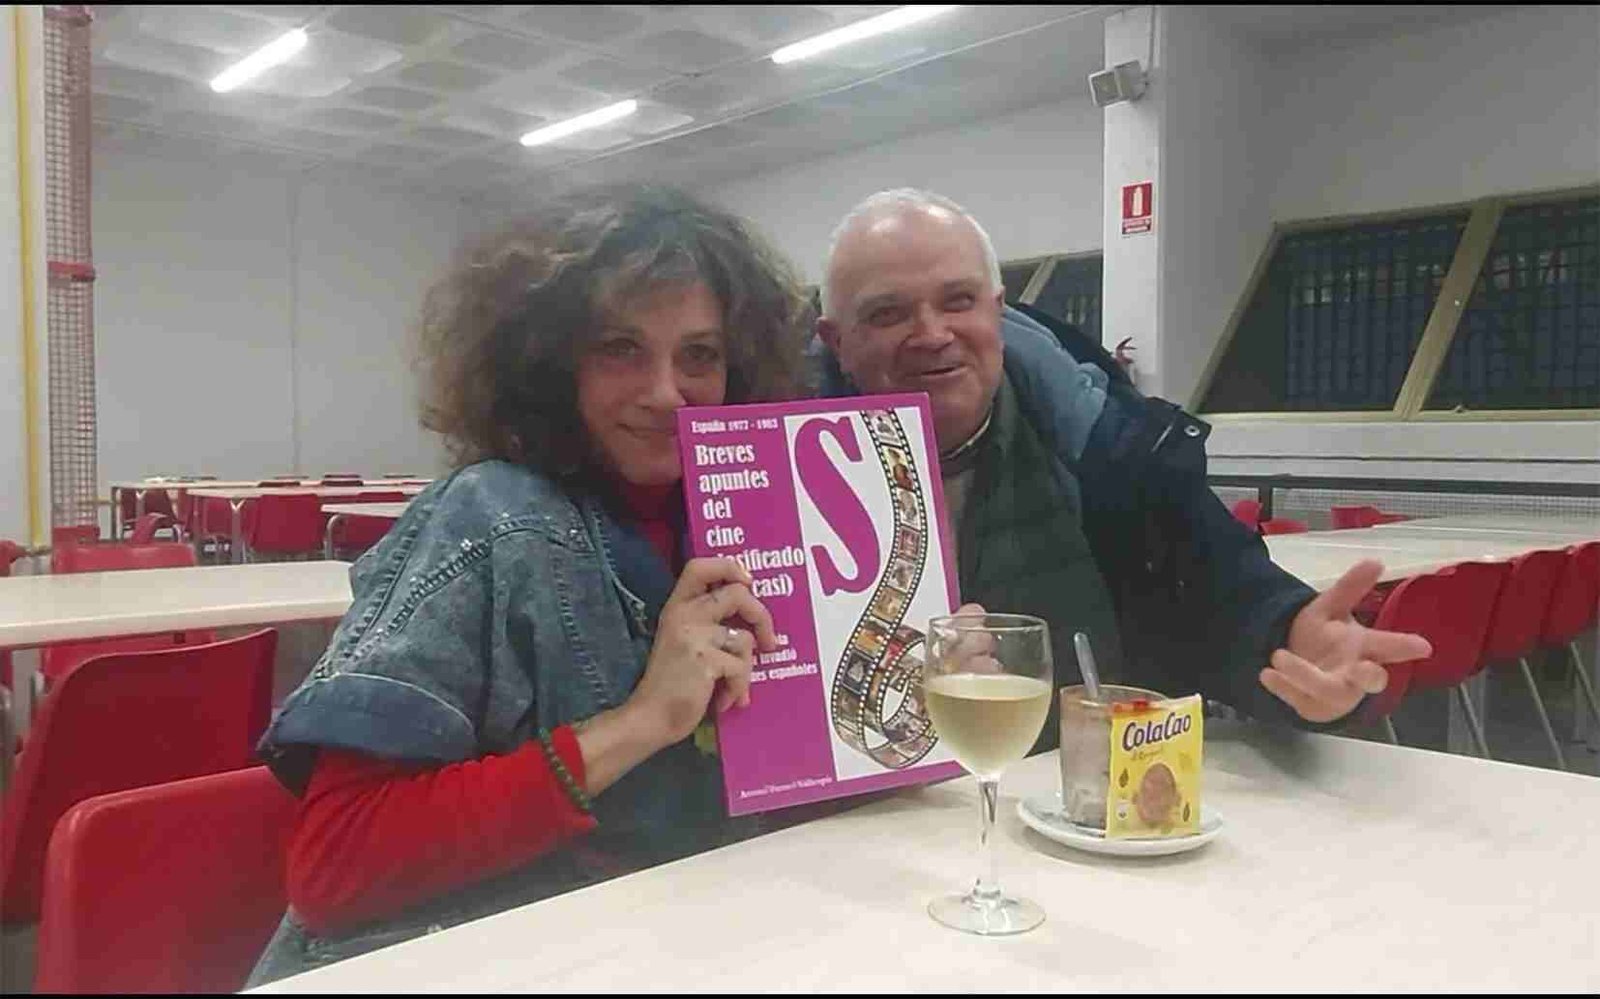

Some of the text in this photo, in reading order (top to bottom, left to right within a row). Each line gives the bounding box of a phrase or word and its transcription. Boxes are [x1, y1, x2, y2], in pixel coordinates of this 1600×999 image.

[694, 444, 755, 466] Breves
[698, 468, 770, 495] apuntes
[702, 497, 733, 520] del
[794, 416, 881, 597] S
[705, 525, 745, 548] cine
[717, 545, 805, 573] sificado
[752, 572, 794, 598] casi)
[1122, 711, 1191, 752] ColaCao
